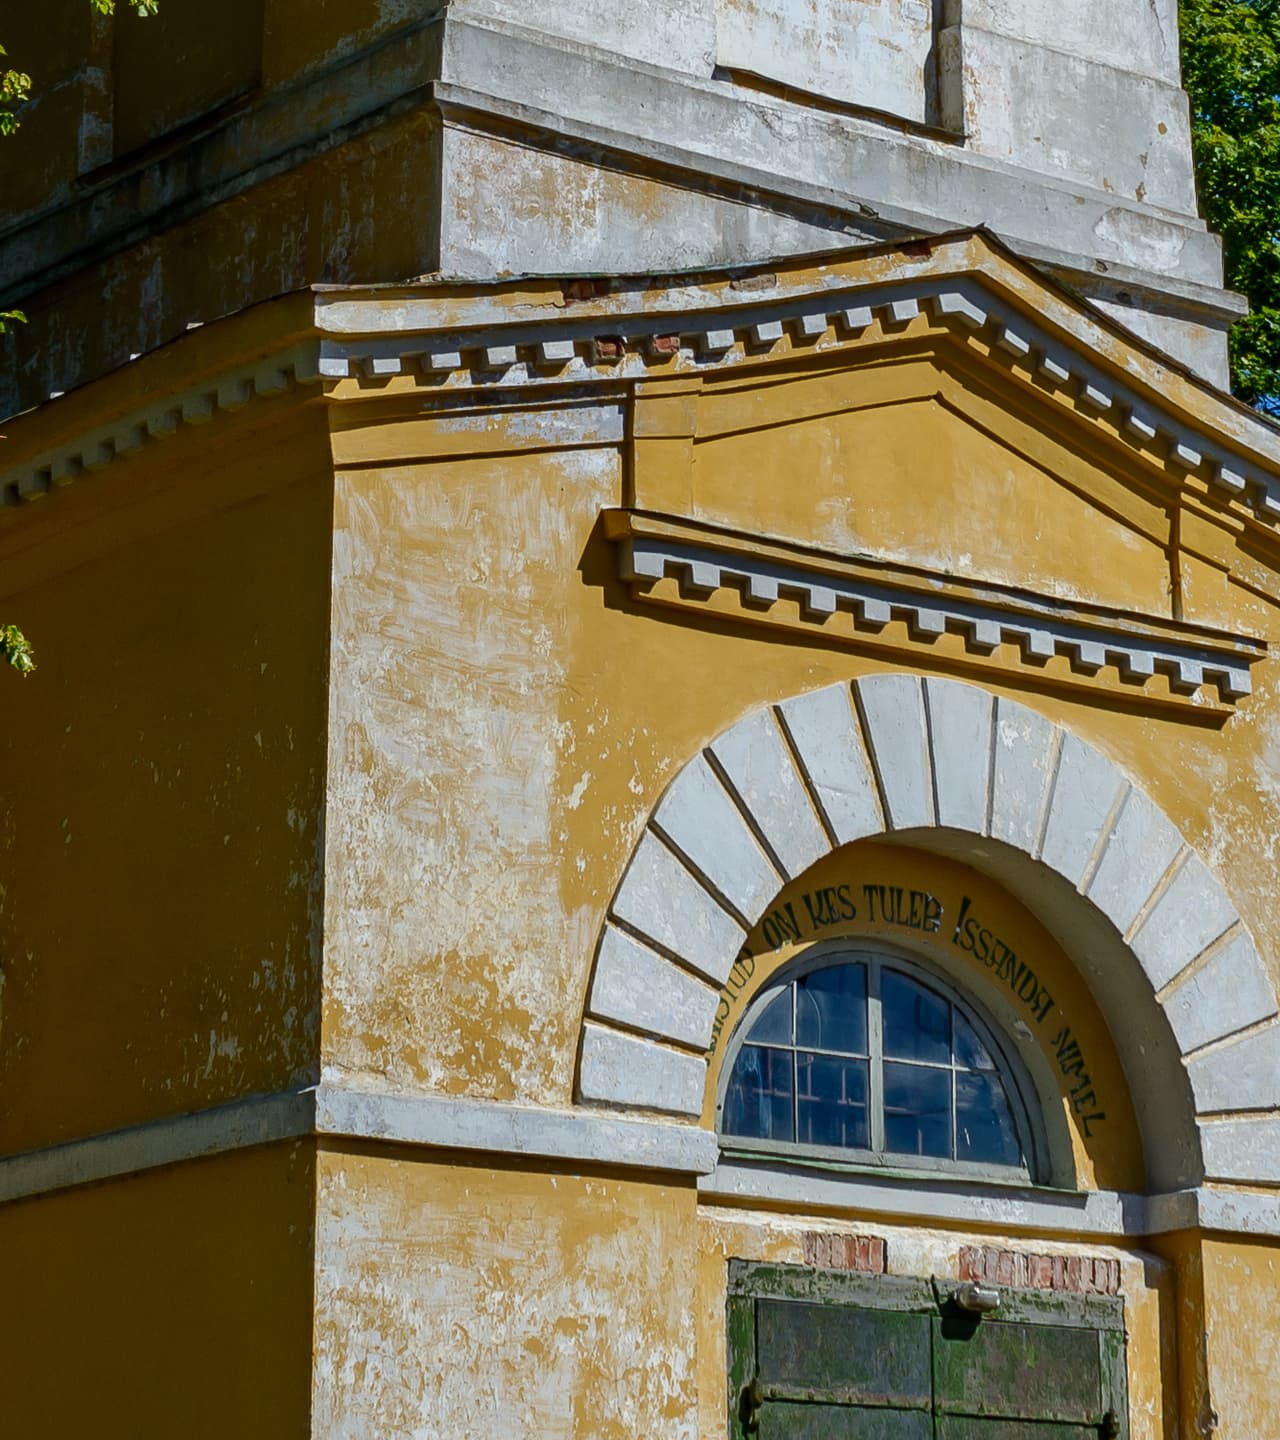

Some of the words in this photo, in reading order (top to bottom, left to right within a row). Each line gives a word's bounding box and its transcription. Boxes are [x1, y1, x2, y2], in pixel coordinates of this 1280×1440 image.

[762, 901, 803, 949] ON
[802, 884, 857, 930] KES
[1051, 1027, 1106, 1138] NIMEL
